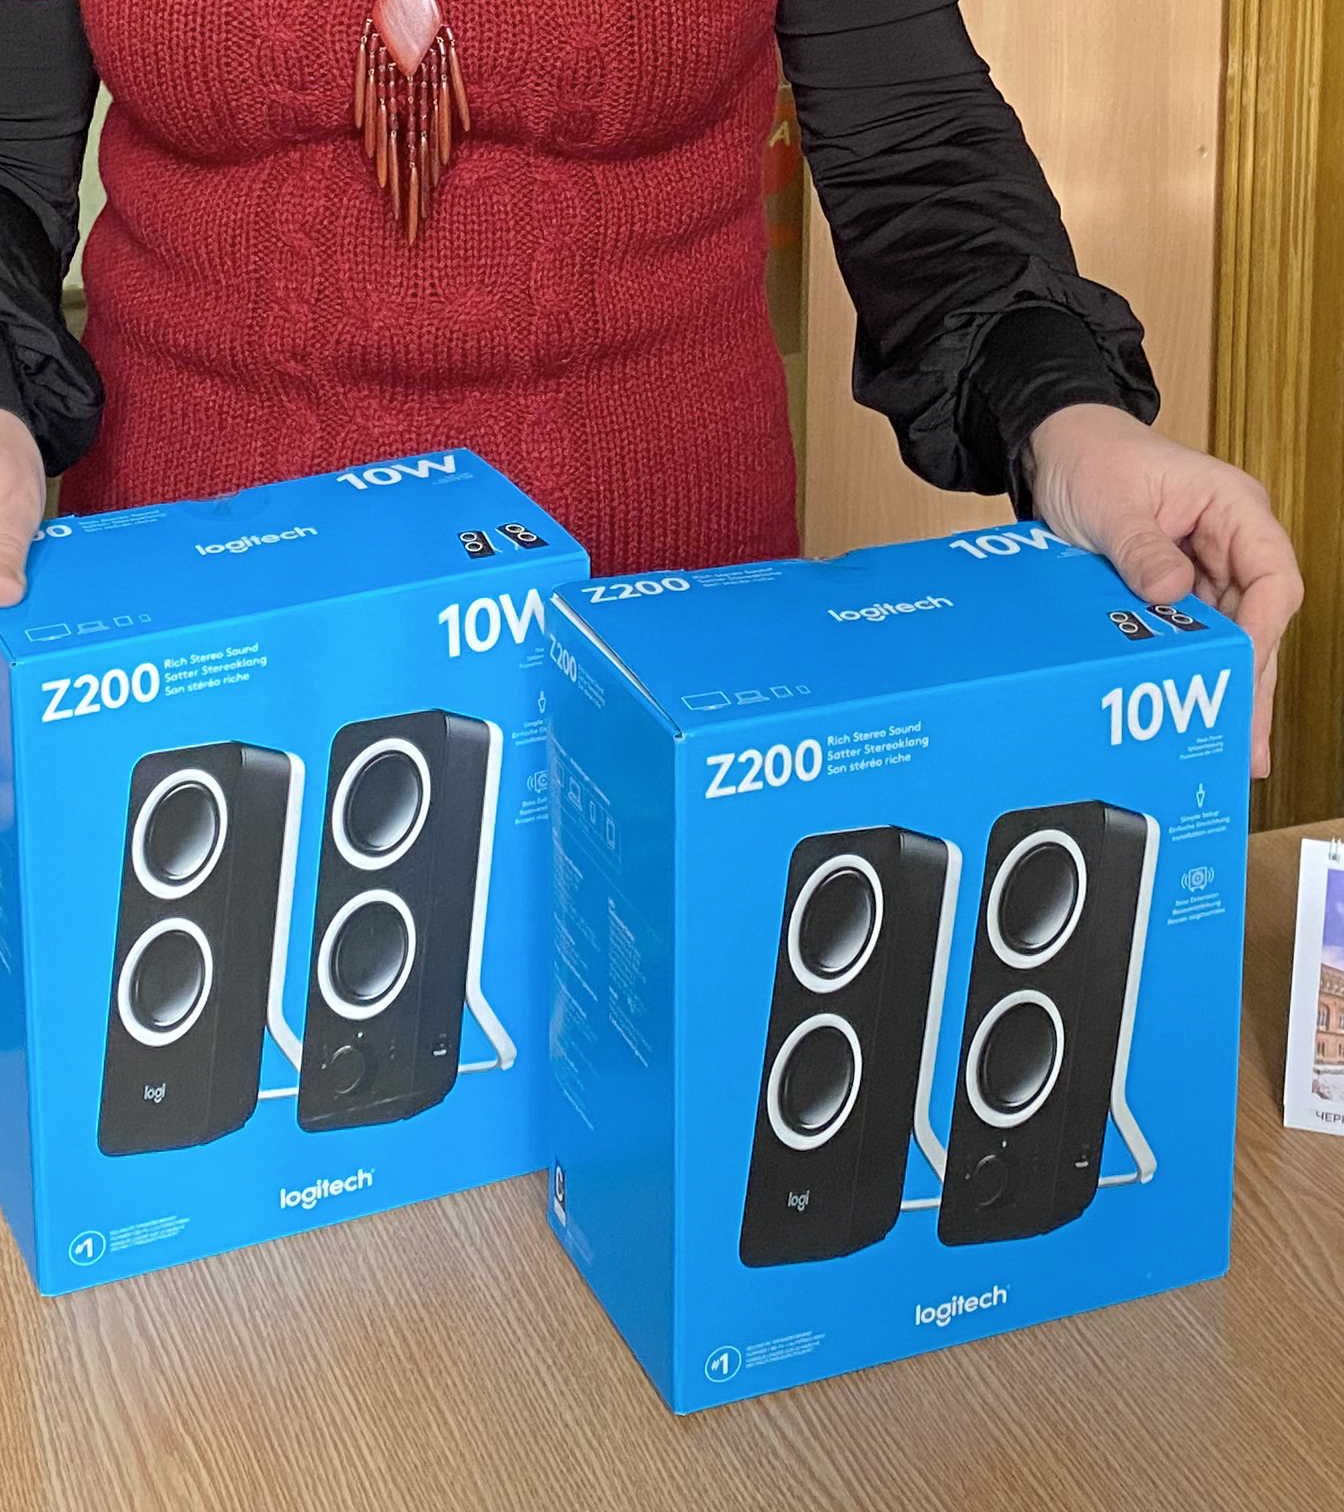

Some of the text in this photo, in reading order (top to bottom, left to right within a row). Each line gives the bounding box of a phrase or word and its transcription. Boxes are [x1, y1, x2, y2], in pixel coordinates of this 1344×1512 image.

[336, 454, 456, 490] 10W
[194, 526, 318, 556] logitech
[581, 577, 691, 604] Z200
[827, 595, 955, 623] logitech
[164, 642, 259, 669] Rich Stereo Sound
[549, 633, 577, 682] Z200
[164, 656, 268, 683] Satter Stereoklang
[223, 672, 250, 686] riche
[41, 662, 160, 723] Z200
[1101, 668, 1232, 746] 10W
[827, 721, 922, 747] Rich Stereo Sound
[827, 736, 929, 761] Satter Stereoklang
[884, 752, 912, 766] riche
[705, 739, 823, 799] Z200
[144, 1083, 166, 1103] logi
[280, 1168, 373, 1210] logitech
[787, 1190, 810, 1212] logi
[915, 1285, 1007, 1327] logitech
